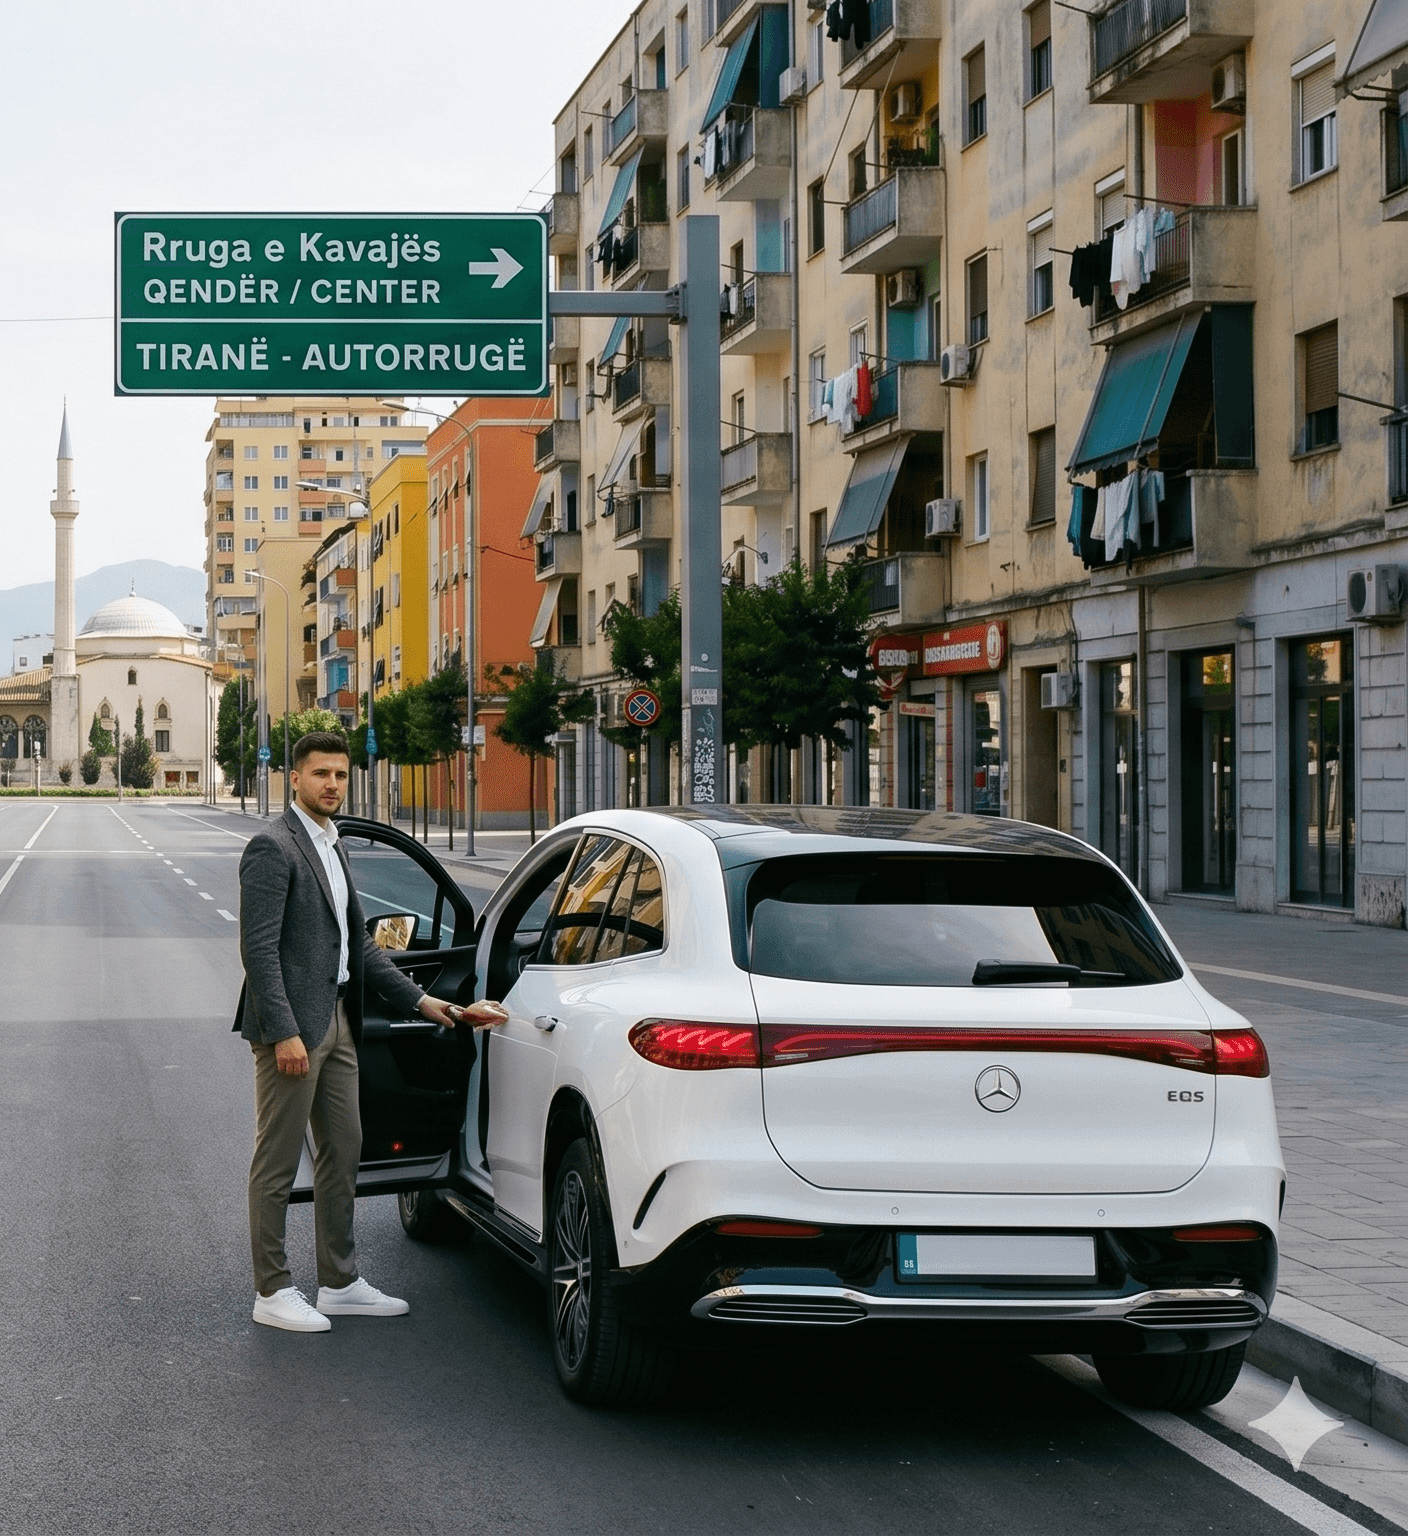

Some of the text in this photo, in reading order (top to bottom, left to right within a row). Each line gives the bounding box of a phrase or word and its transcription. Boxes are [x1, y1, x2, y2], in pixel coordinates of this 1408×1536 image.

[143, 231, 441, 269] Rruga e Kavajës
[143, 273, 441, 305] QENDËR / CENTER
[136, 336, 269, 371] TIRANË
[301, 337, 526, 372] AUTORRUGË
